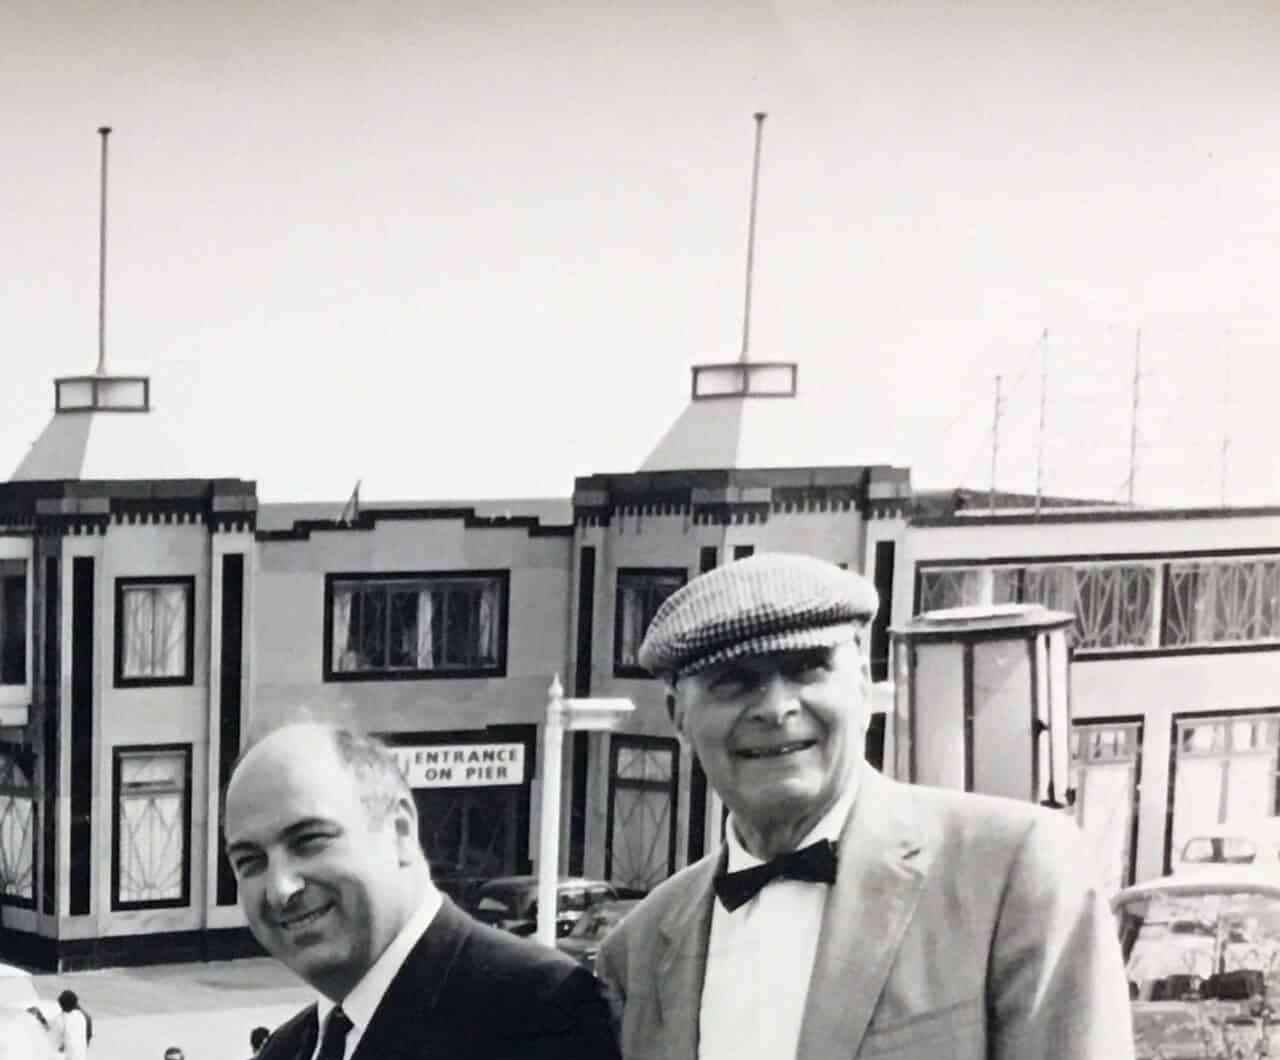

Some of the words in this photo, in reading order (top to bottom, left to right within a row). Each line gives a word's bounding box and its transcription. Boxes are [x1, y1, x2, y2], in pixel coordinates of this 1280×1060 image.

[415, 749, 517, 764] ENTRANCE
[424, 767, 453, 781] ON
[465, 766, 508, 780] PIER
